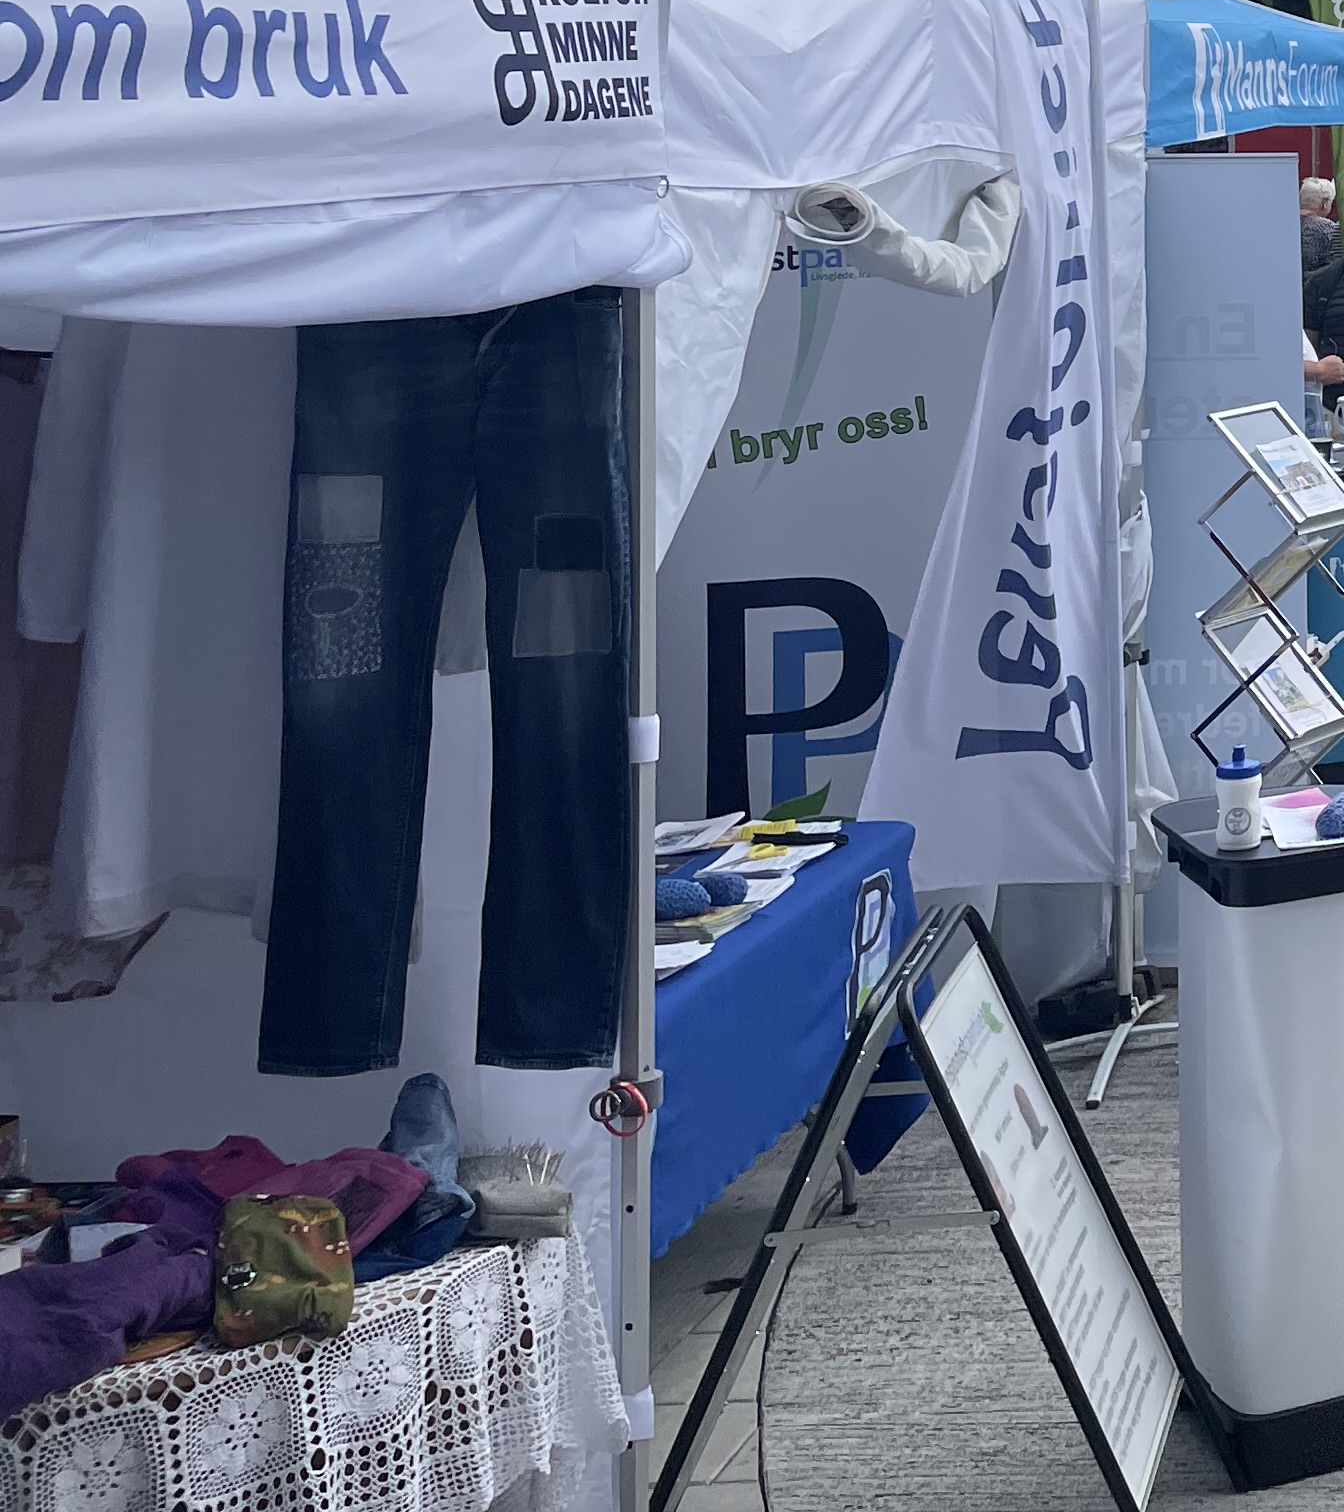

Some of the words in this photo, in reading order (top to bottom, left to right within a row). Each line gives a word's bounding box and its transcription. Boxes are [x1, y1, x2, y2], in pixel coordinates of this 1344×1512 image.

[547, 20, 638, 63] MINNE
[562, 75, 654, 122] DAGENE
[1224, 40, 1341, 113] MannsForum
[730, 422, 824, 465] bryr
[837, 395, 929, 444] oss!
